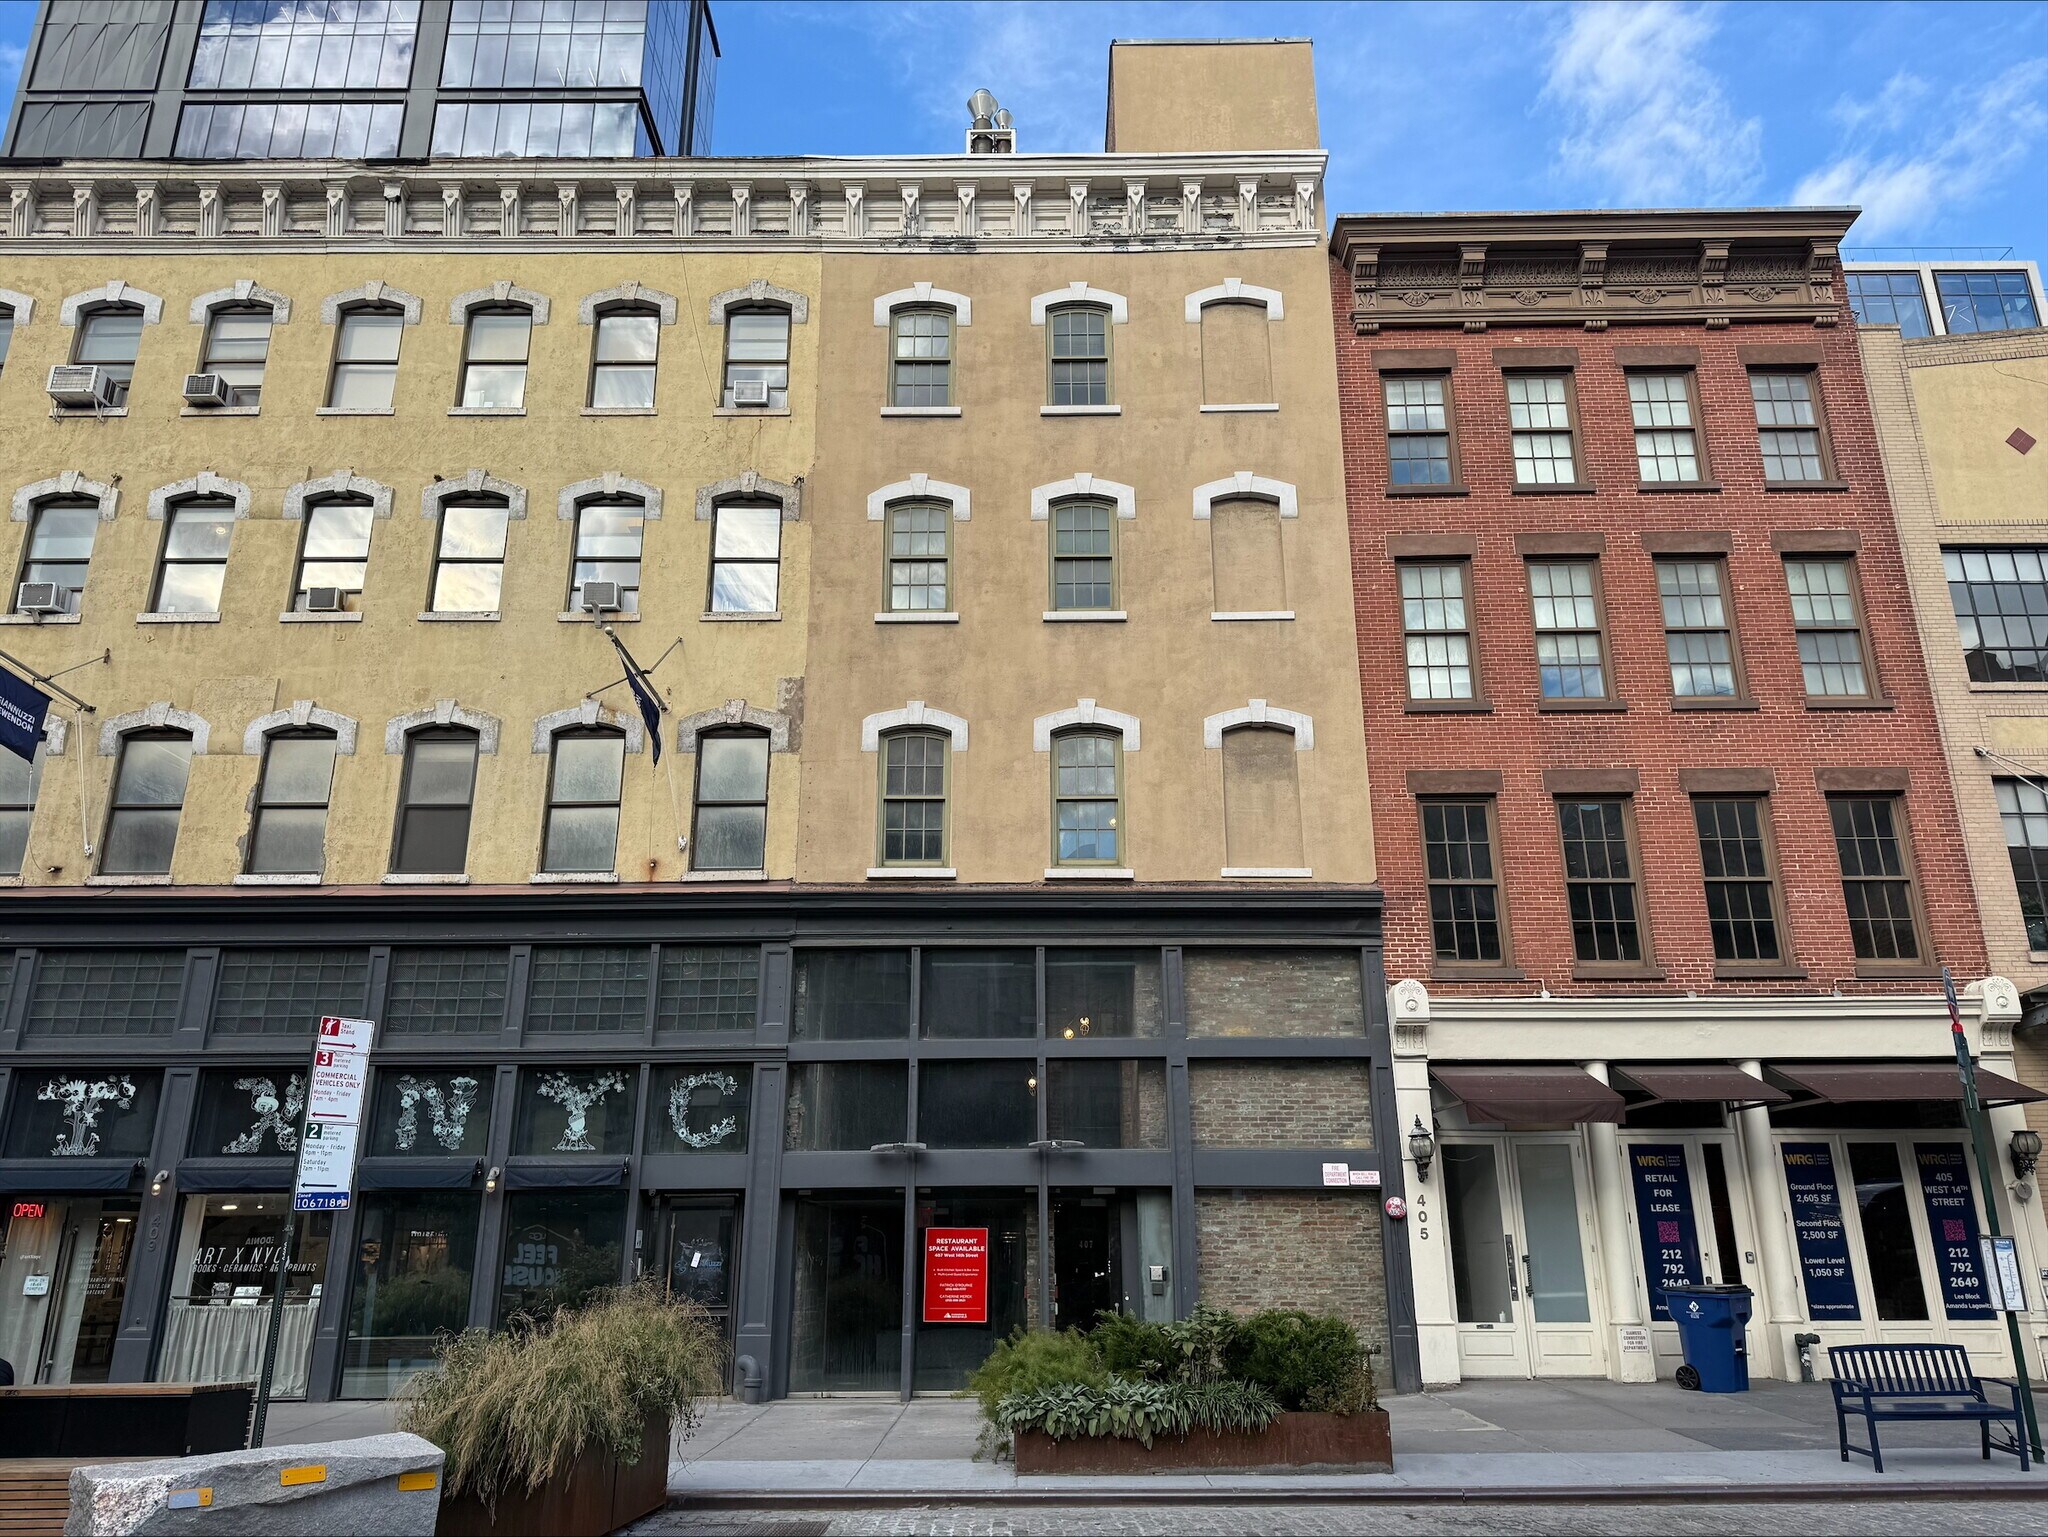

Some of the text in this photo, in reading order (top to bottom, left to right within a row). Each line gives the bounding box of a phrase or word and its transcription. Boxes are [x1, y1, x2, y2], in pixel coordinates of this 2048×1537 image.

[320, 1052, 329, 1065] 3
[316, 1071, 357, 1080] COMMERCIAL
[315, 1079, 361, 1089] VEHICLES ONLY
[309, 1124, 319, 1138] 2
[1637, 1156, 1665, 1167] WRG
[1785, 1154, 1814, 1165] WRG
[1918, 1154, 1947, 1165] WRG
[1645, 1174, 1678, 1182] RETAIL
[1935, 1173, 1952, 1181] 405
[1654, 1189, 1672, 1197] FOR
[1924, 1186, 1948, 1194] WEST
[297, 1199, 336, 1208] 106718
[1796, 1194, 1831, 1203] 2,605 SF
[1932, 1198, 1965, 1206] STREET
[13, 1203, 44, 1218] OPEN
[1650, 1204, 1680, 1212] LEASE
[1417, 1194, 1429, 1240] 405
[1803, 1231, 1839, 1240] 2,500 SF
[1079, 1240, 1093, 1248] 407
[193, 1247, 227, 1264] ART
[232, 1247, 245, 1263] X
[250, 1247, 282, 1263] NYC
[1661, 1249, 1682, 1260] 212
[1948, 1247, 1970, 1258] 212
[192, 1264, 218, 1273] BOOKS
[223, 1264, 263, 1272] CERAMICS
[287, 1263, 317, 1272] PRINTS
[1663, 1264, 1685, 1274] 792
[1950, 1262, 1973, 1272] 792
[1809, 1268, 1844, 1278] 1,050 SF
[1662, 1279, 1690, 1288] 2649
[1950, 1277, 1979, 1287] 2649
